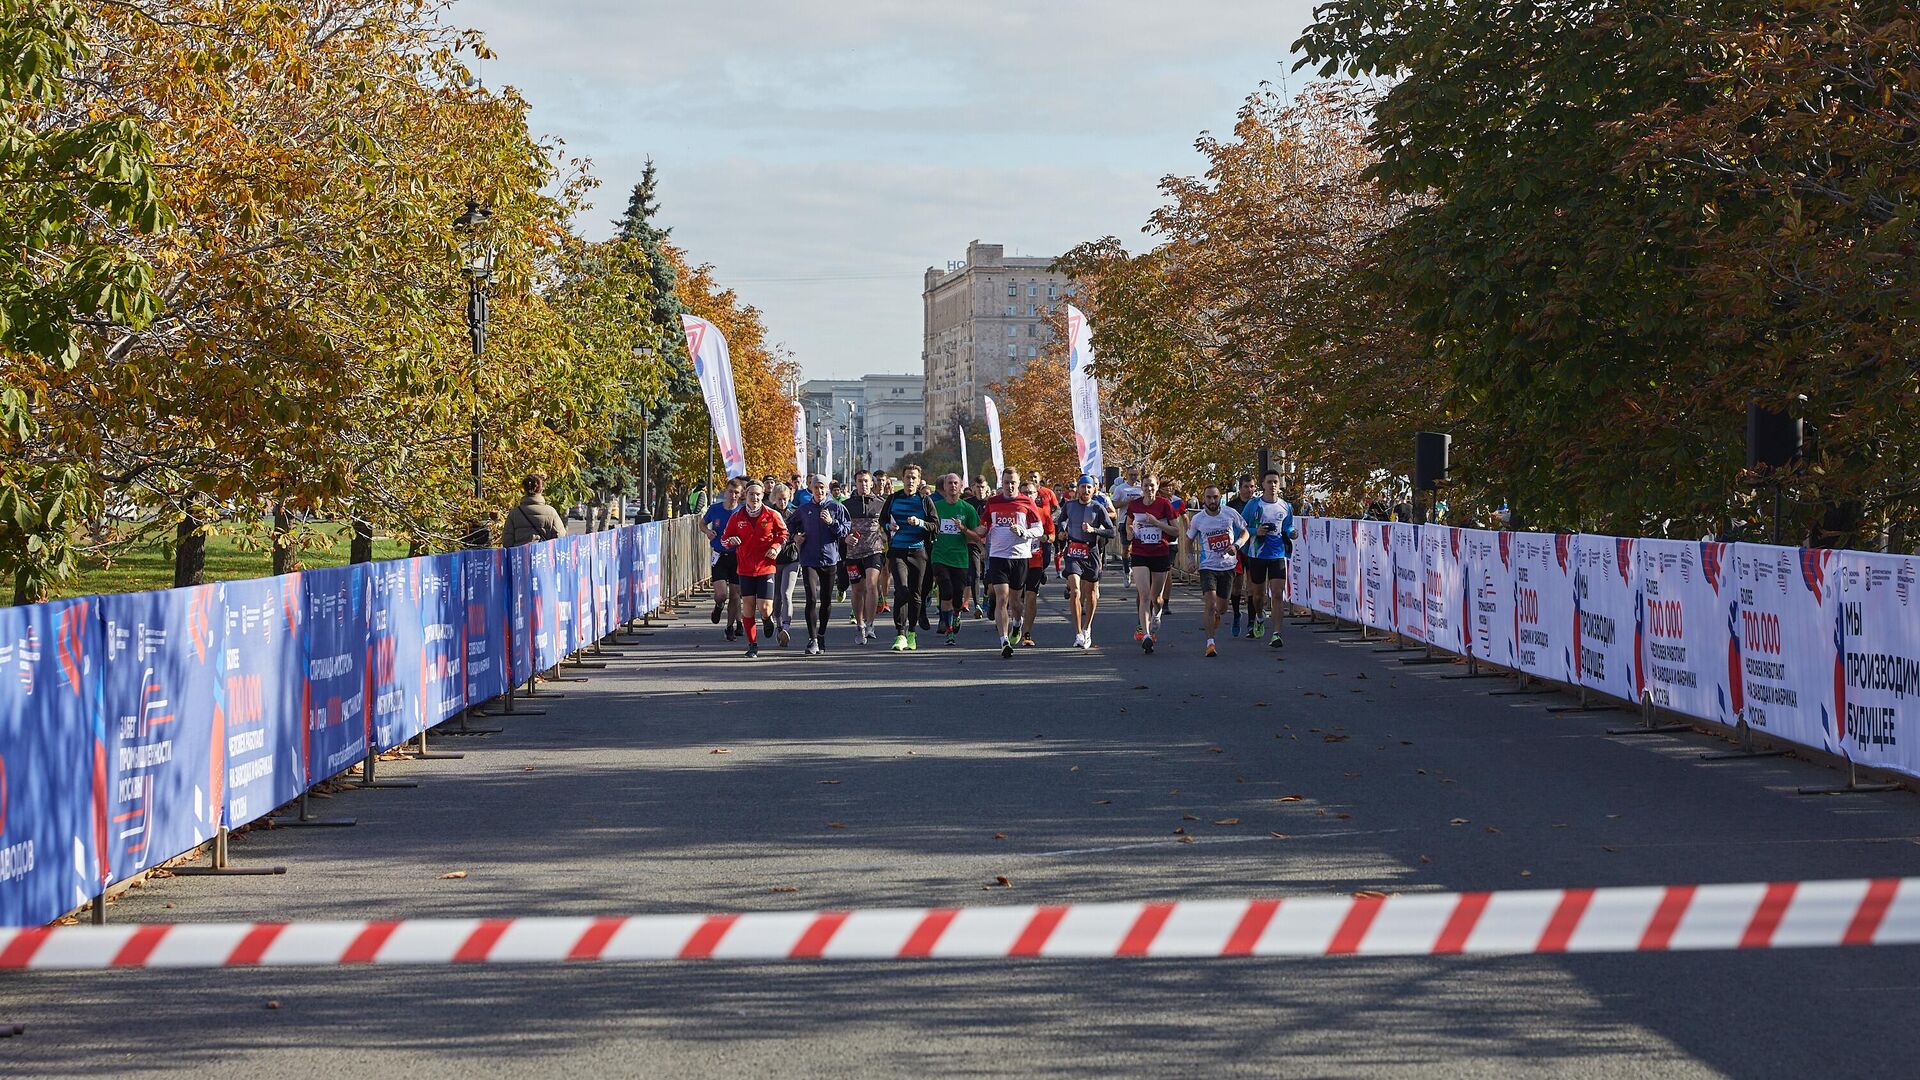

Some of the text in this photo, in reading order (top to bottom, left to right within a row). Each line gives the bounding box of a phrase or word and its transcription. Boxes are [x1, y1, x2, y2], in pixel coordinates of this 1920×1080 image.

[944, 524, 957, 532] 523
[1211, 540, 1228, 549] 2017
[1580, 574, 1588, 600] МЫ
[1524, 588, 1538, 624] 000
[1648, 598, 1682, 639] 700 000
[1846, 602, 1862, 636] МЫ
[1580, 609, 1616, 648] ПРОИЗВОДИМ
[1742, 610, 1780, 654] 700 000
[1582, 645, 1605, 683] БУДУЩЕЕ
[1763, 661, 1785, 680] РАБОТАЮТ
[1847, 652, 1920, 699] ПРОИЗВОДИМ
[1748, 703, 1766, 726] МОСКВЫ
[1775, 688, 1798, 708] ФАБРИКАХ
[1848, 702, 1896, 752] БУДУЩЕЕ
